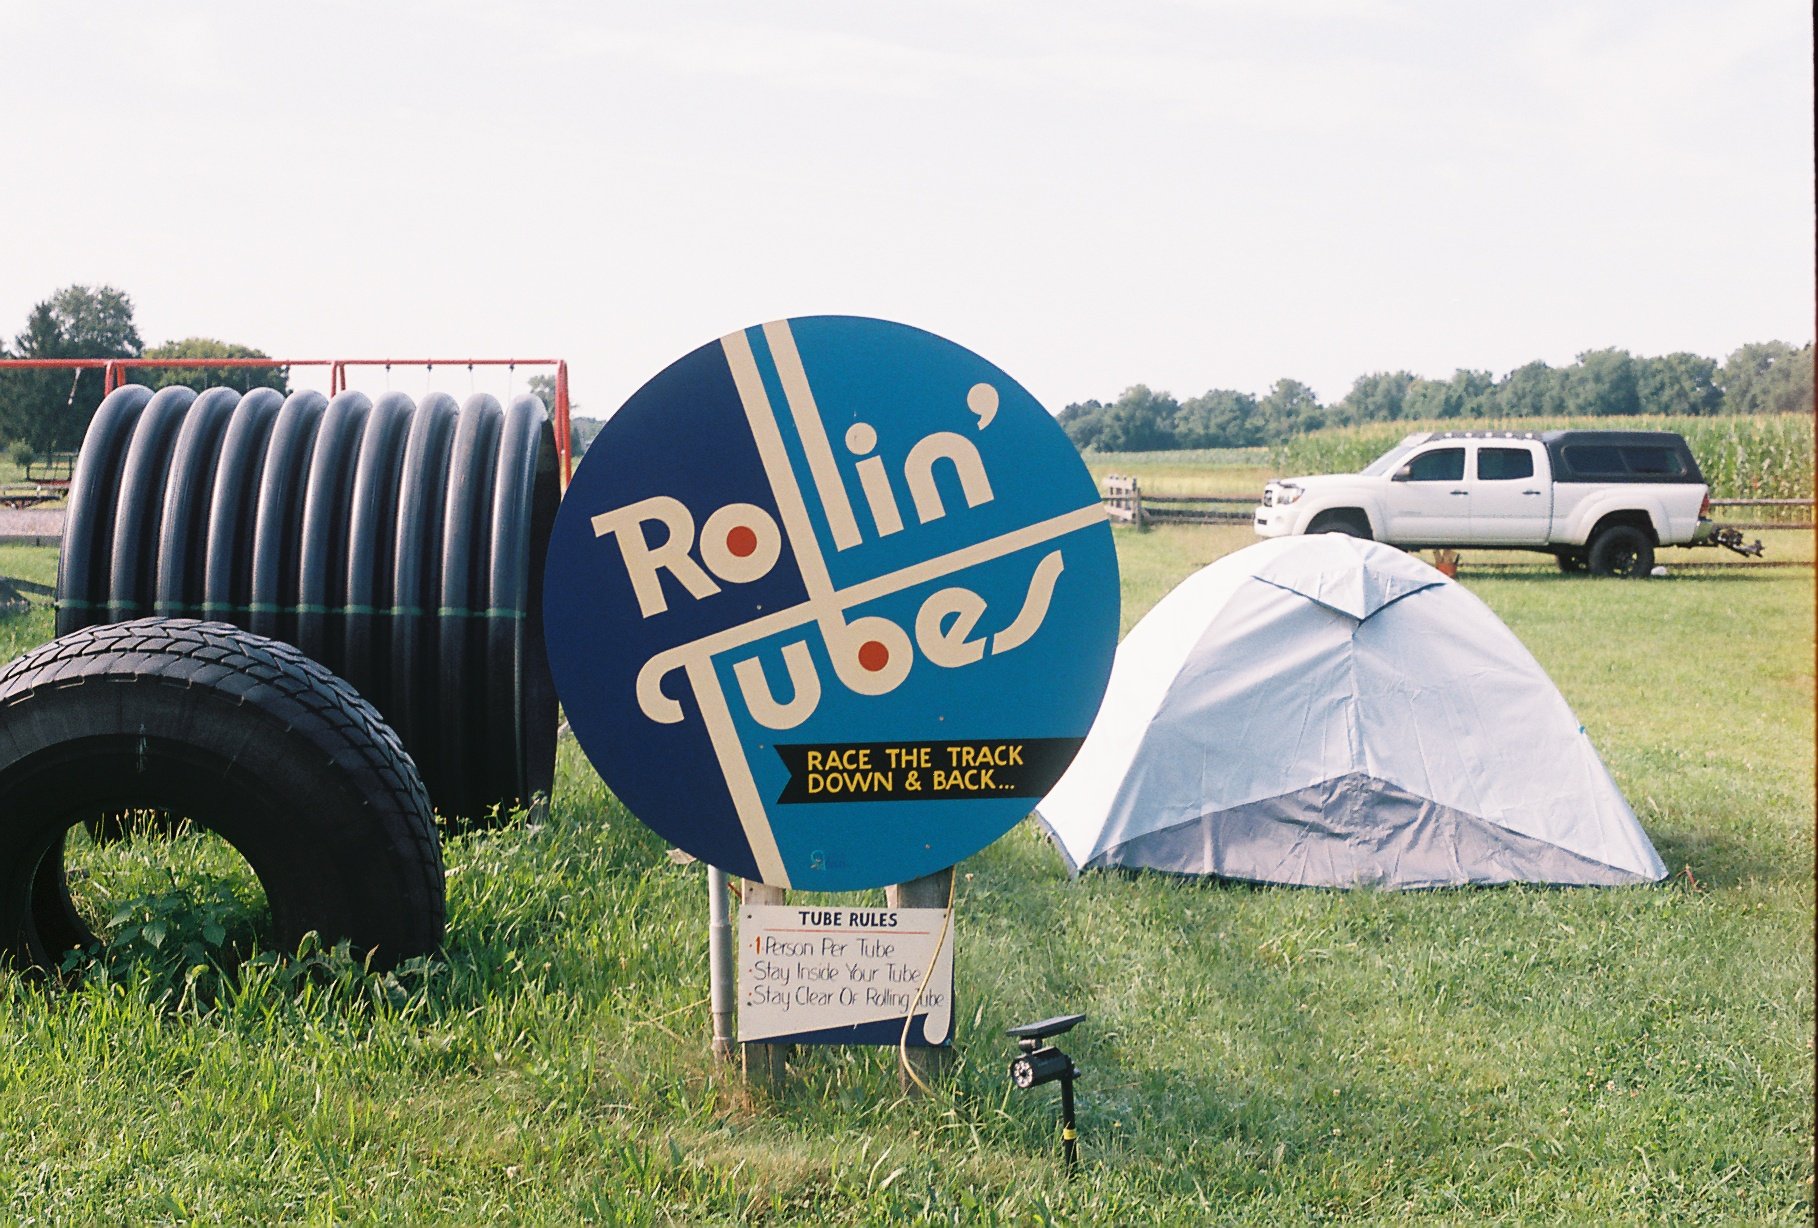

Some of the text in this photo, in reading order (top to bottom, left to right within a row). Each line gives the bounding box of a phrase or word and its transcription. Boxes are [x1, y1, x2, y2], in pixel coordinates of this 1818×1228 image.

[591, 319, 999, 619] Rollin'
[807, 745, 1024, 771] RACE THE TRACK
[807, 771, 893, 794] DOWN
[904, 770, 922, 791] &
[799, 911, 898, 927] TUBE RULES
[755, 936, 895, 957] 1 Person Per Tube
[753, 960, 921, 985] Stay Inside Your Tube
[753, 984, 790, 1011] Stay
[795, 986, 834, 1005] Clear
[866, 988, 909, 1014] Rolling
[914, 987, 944, 1006] ube
